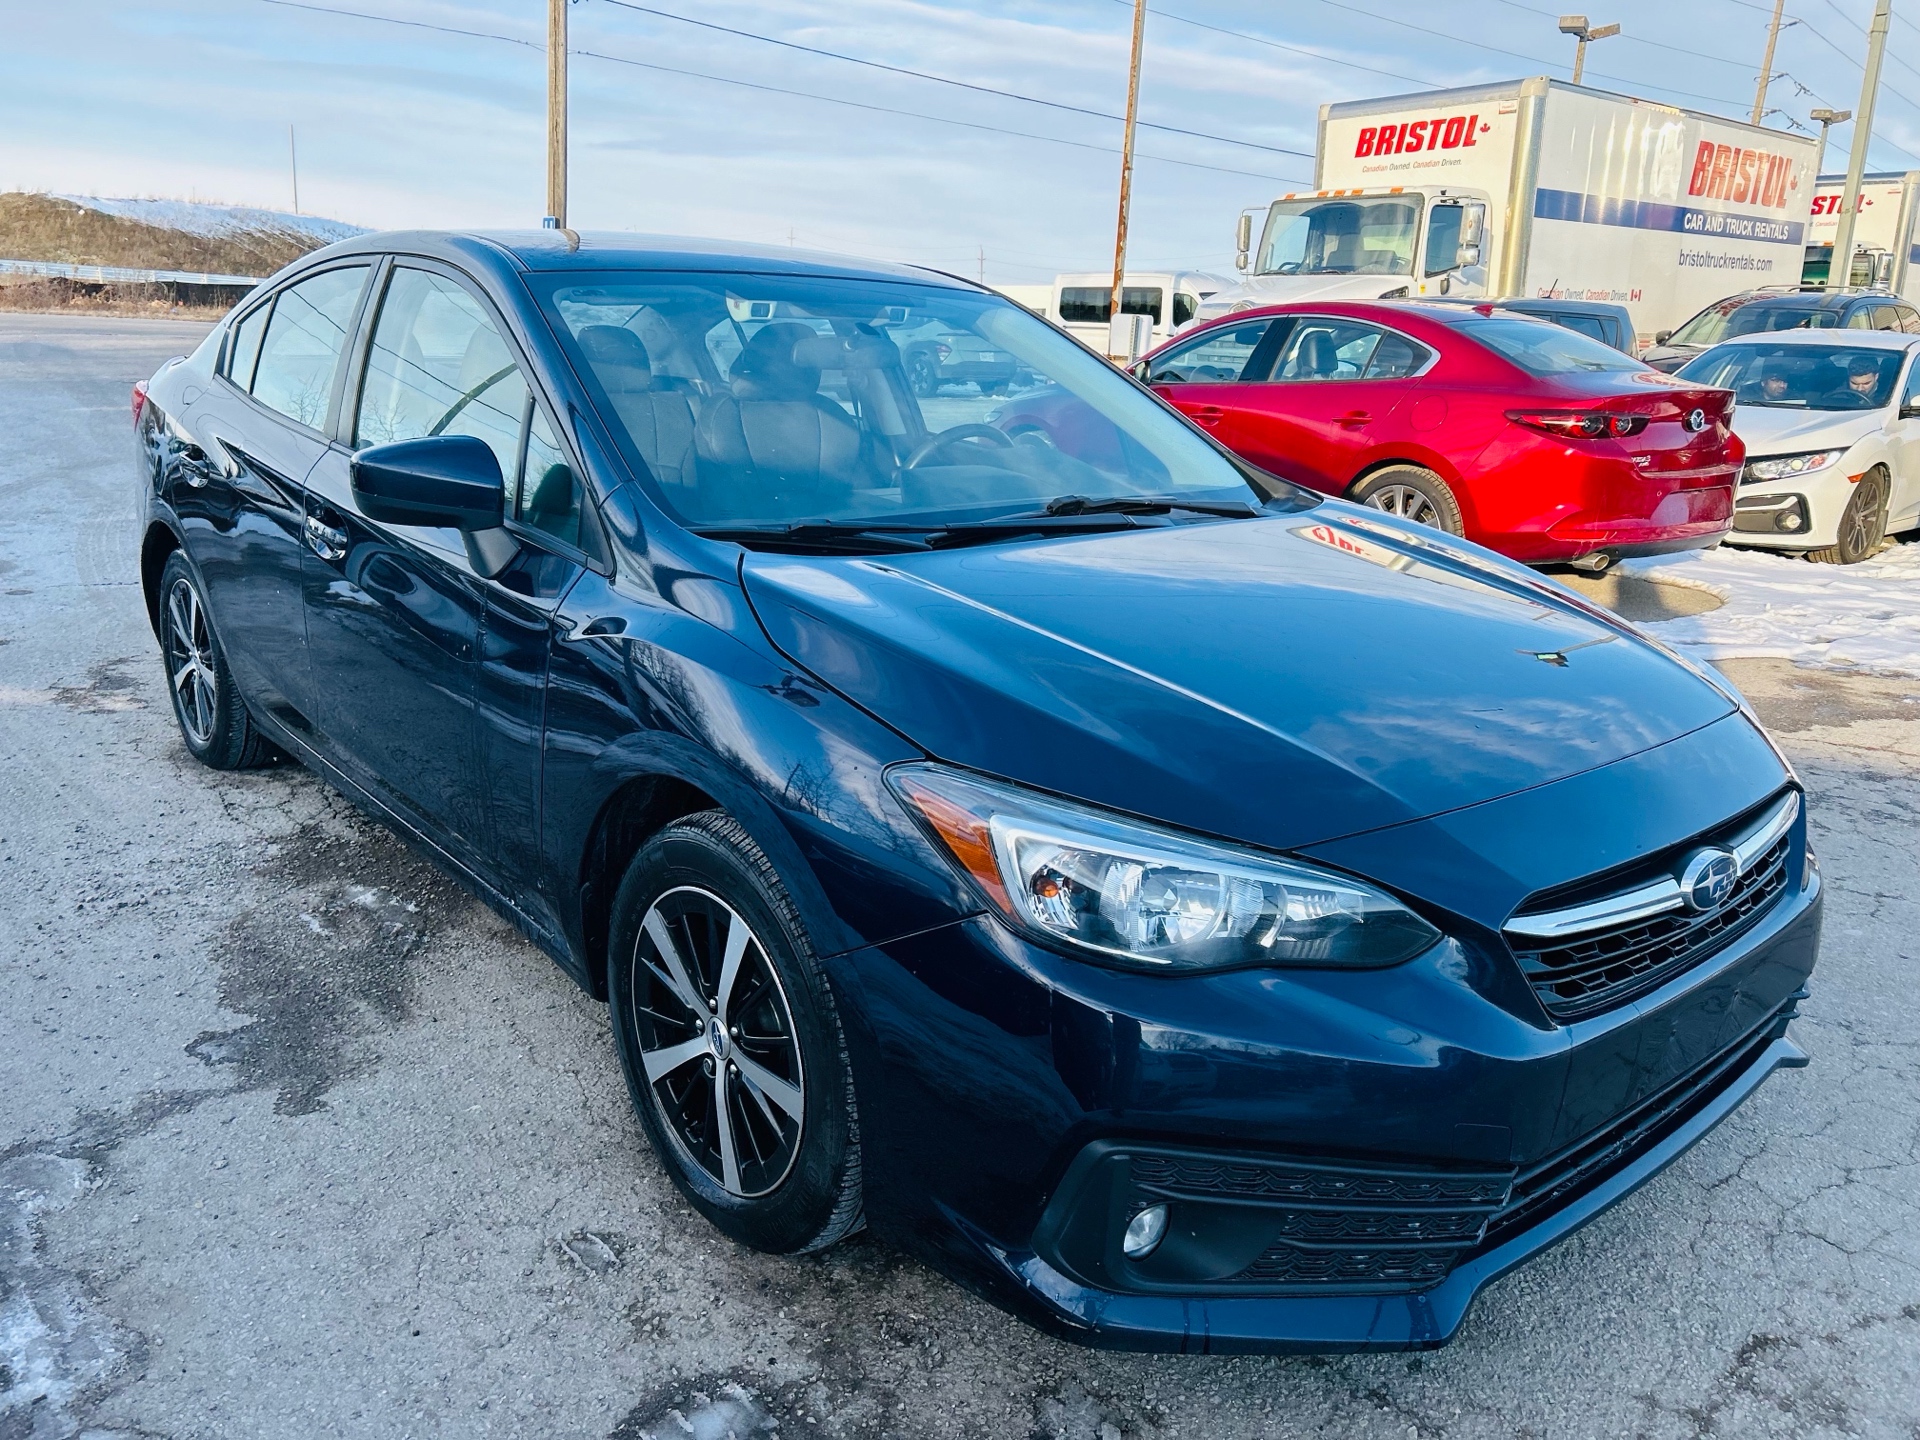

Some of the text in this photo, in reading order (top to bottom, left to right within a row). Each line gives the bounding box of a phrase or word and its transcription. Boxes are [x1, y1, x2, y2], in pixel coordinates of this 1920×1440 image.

[1354, 114, 1479, 158] BRISTOL
[1362, 164, 1388, 173] Canadian
[1412, 160, 1440, 169] Canadian
[1688, 140, 1793, 209] BRISTOL
[1684, 213, 1789, 240] CAR AND TRUCK RENTALS
[1678, 249, 1773, 271] bristoltruckrentals.com
[1585, 289, 1610, 301] Canadian
